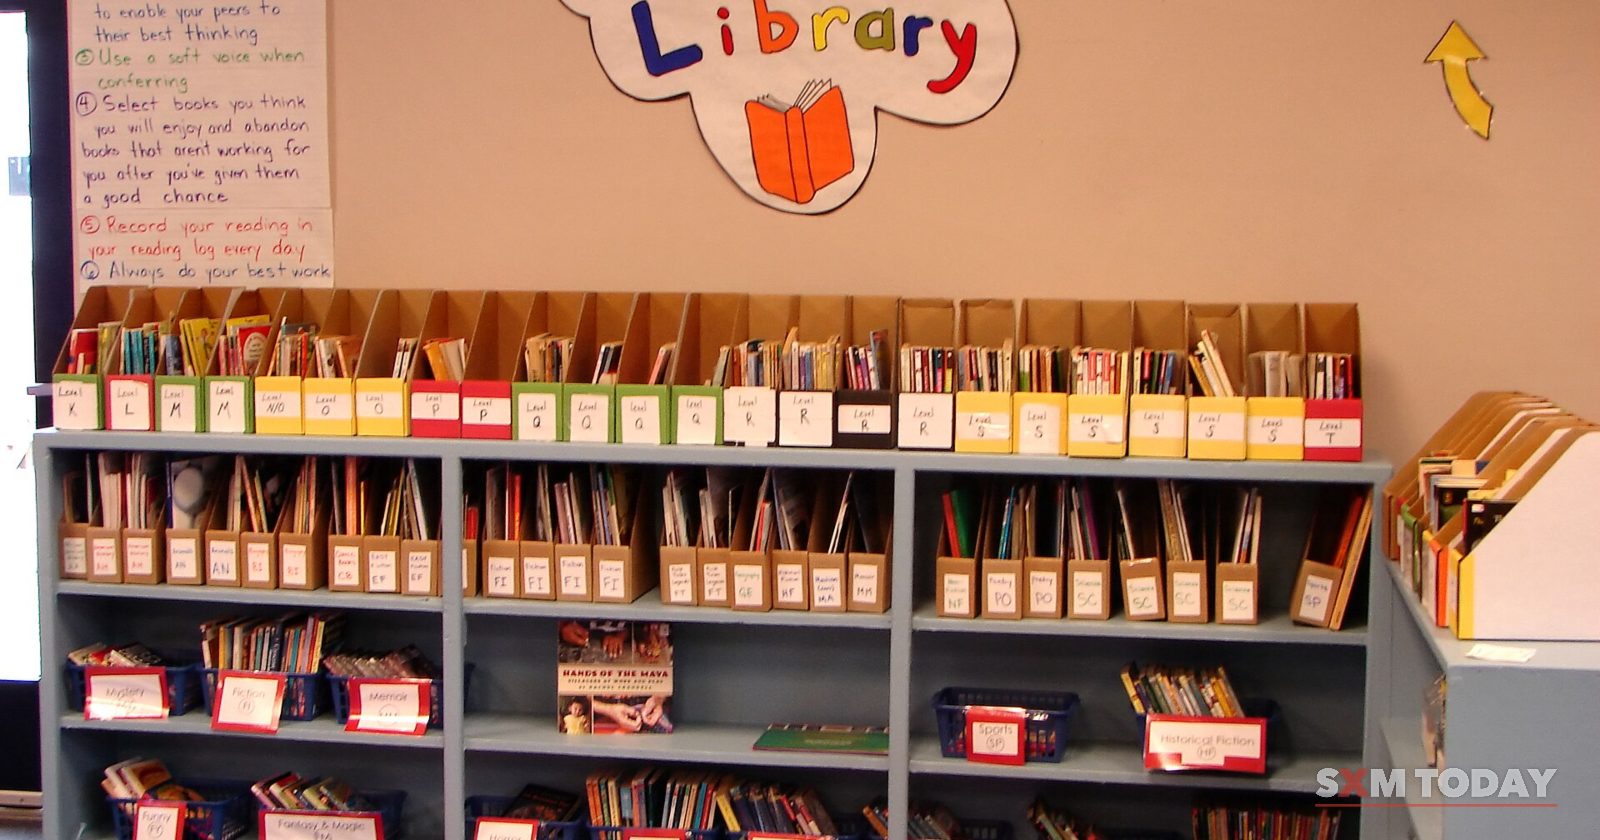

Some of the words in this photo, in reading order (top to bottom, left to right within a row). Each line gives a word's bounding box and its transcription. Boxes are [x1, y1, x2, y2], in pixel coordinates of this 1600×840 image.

[95, 3, 111, 19] to
[120, 3, 166, 17] enable
[176, 5, 203, 23] your
[214, 4, 250, 23] peers
[260, 0, 280, 15] to
[95, 25, 130, 42] their
[140, 26, 172, 42] best
[185, 24, 258, 46] thinking
[99, 47, 131, 66] Use
[147, 54, 156, 64] a
[169, 47, 200, 65] soft
[212, 51, 250, 63] voice
[260, 48, 304, 63] when
[631, 0, 977, 94] Library
[98, 72, 188, 94] conferring
[102, 94, 158, 112] Select
[173, 94, 219, 110] books
[230, 99, 253, 115] you
[260, 93, 305, 109] think
[95, 122, 115, 139] you
[128, 118, 154, 133] will
[163, 119, 203, 140] enjoy
[208, 118, 232, 133] and
[245, 119, 309, 133] abandon
[81, 142, 120, 158] books
[131, 141, 163, 157] that
[217, 142, 273, 163] working
[285, 138, 310, 156] for
[83, 171, 106, 188] you
[117, 166, 155, 180] after
[214, 167, 249, 186] given
[255, 163, 299, 180] them
[83, 195, 91, 204] a
[103, 190, 142, 209] good
[163, 189, 228, 203] chance
[107, 216, 168, 233] Record
[181, 220, 215, 238] your
[225, 217, 289, 238] reading
[298, 217, 313, 232] in
[88, 244, 117, 260] your
[131, 240, 181, 262] reading
[194, 238, 215, 261] log
[224, 244, 261, 262] every
[272, 238, 306, 264] day
[109, 262, 164, 284] Always
[178, 262, 196, 277] do
[206, 266, 238, 283] your
[248, 262, 286, 278] best
[292, 264, 330, 278] work
[125, 403, 134, 415] L
[169, 402, 182, 418] M
[217, 401, 232, 418] M
[432, 403, 440, 417] P
[479, 409, 488, 421] P
[800, 408, 811, 425] R
[1034, 425, 1043, 438] S
[1325, 432, 1336, 444] T
[641, 670, 668, 678] MAYA
[978, 723, 1013, 736] Sports
[1160, 734, 1212, 746] Historical
[1216, 736, 1255, 747] Fiction
